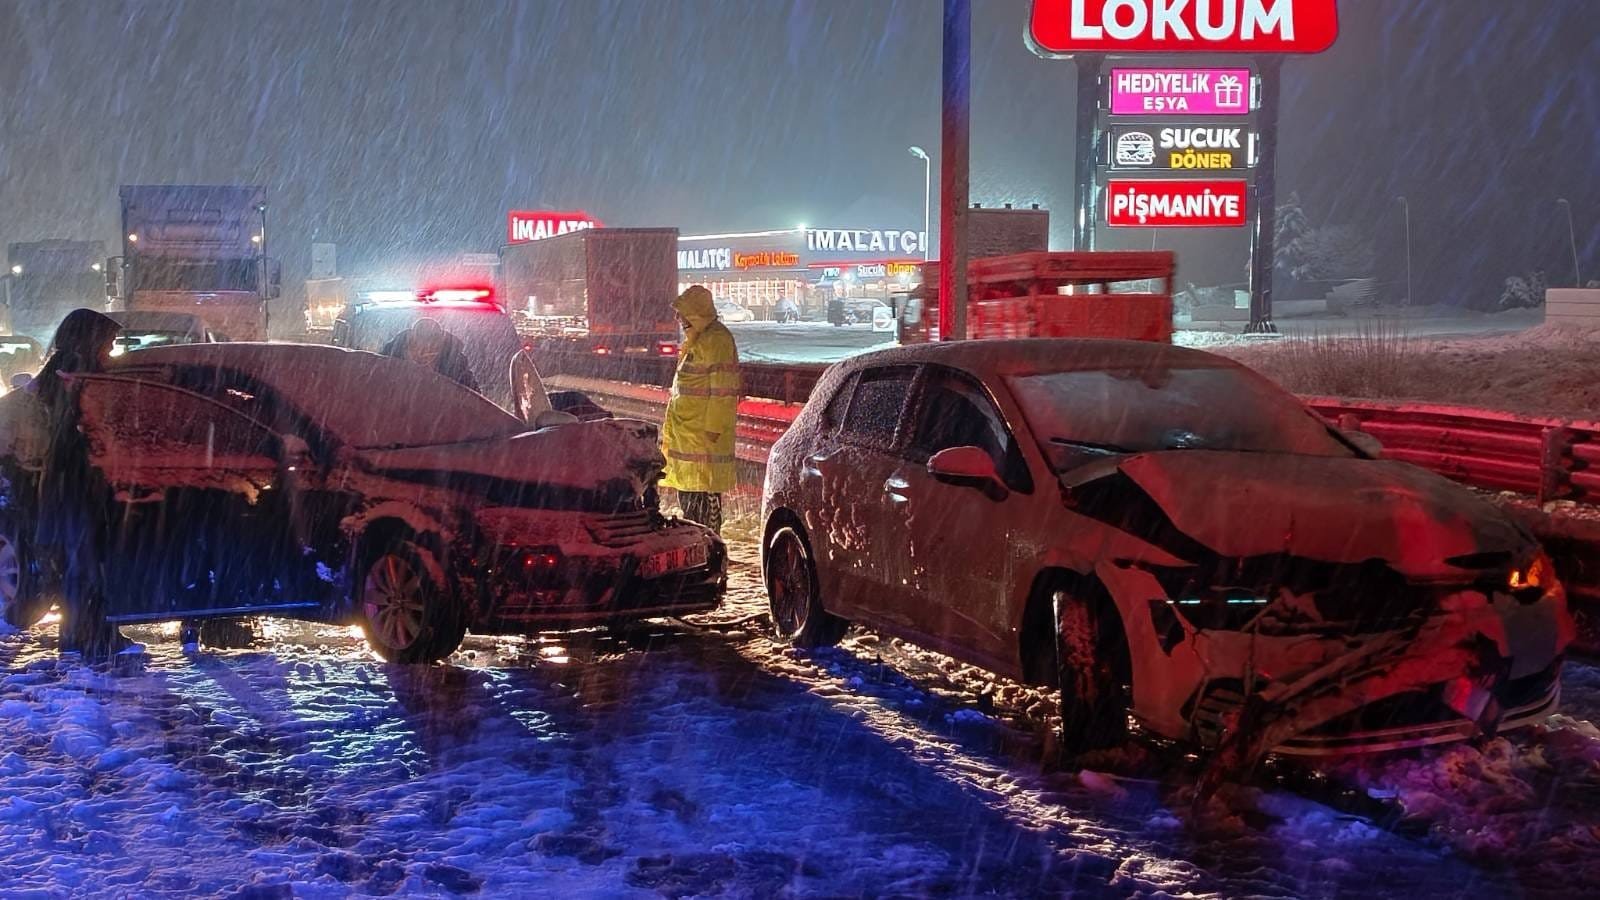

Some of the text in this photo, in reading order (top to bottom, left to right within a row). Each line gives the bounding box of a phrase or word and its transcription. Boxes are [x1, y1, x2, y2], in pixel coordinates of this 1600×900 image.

[1070, 0, 1295, 41] LOKUM
[1118, 73, 1210, 94] HEDİYELİK
[1143, 96, 1189, 112] EŞYA
[1160, 128, 1241, 149] SUCUK
[1170, 149, 1232, 169] DÖNER
[1113, 187, 1240, 224] PİŞMANİYE
[807, 230, 926, 254] İMALATÇI
[677, 247, 731, 271] MALATÇI
